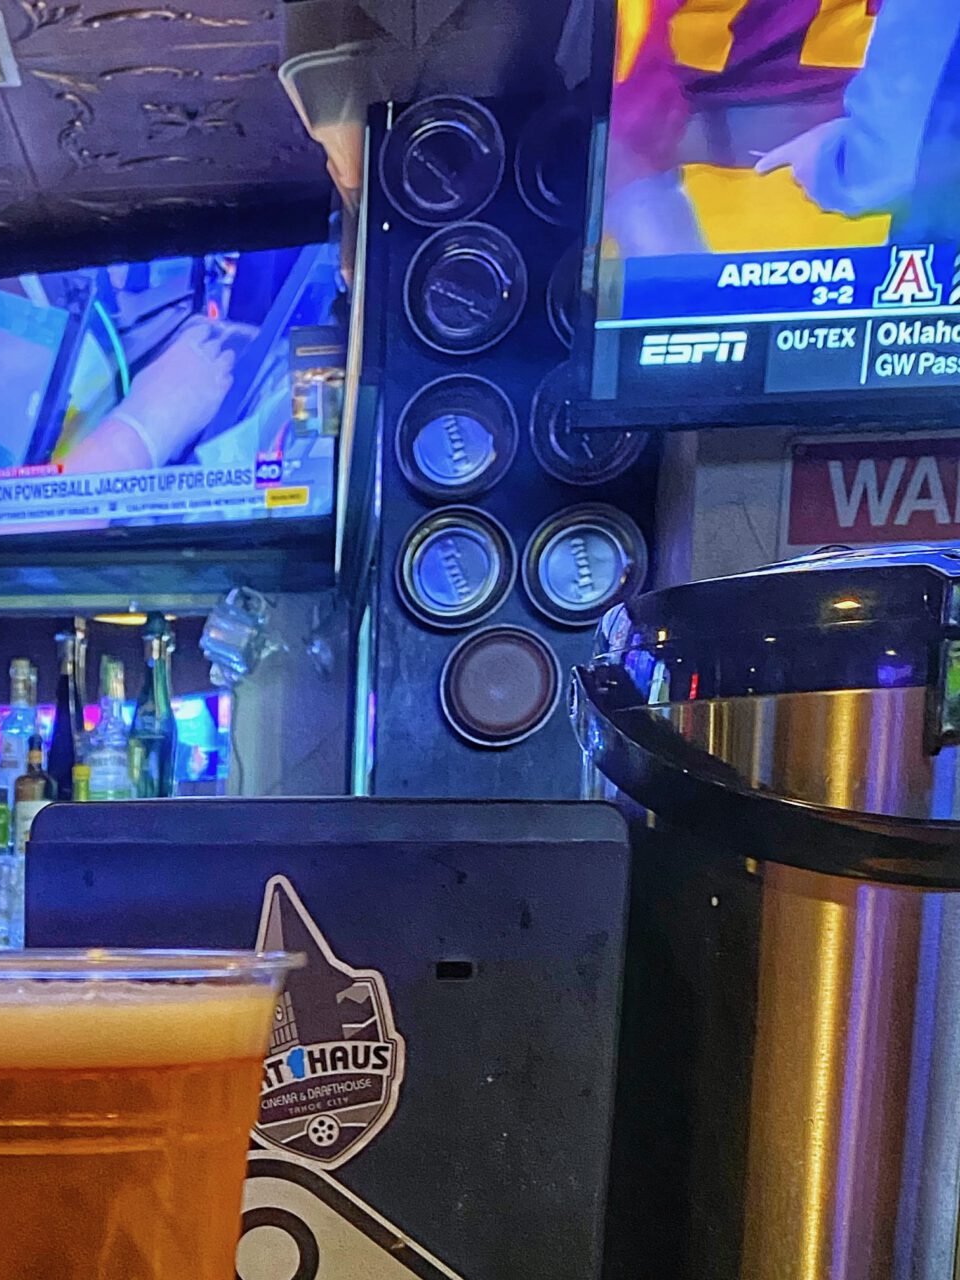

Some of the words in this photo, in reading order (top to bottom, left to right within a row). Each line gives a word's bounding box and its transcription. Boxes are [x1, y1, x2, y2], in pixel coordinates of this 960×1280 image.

[717, 258, 856, 287] ARIZONA
[812, 286, 854, 305] 3-2
[640, 331, 748, 365] ESPN
[777, 327, 856, 351] OU-TEX
[875, 353, 916, 377] GW
[15, 479, 93, 501] POWERBALL
[95, 475, 155, 496] JACKPOT
[158, 476, 176, 491] UP
[178, 473, 205, 490] FOR
[206, 469, 252, 488] GRABS
[828, 456, 960, 528] WA
[307, 1045, 390, 1075] HAUS
[261, 1091, 298, 1109] CINEMA
[307, 1078, 372, 1099] DRAFTHOUSE
[288, 1103, 321, 1115] TAHOE
[327, 1097, 349, 1107] CITY
